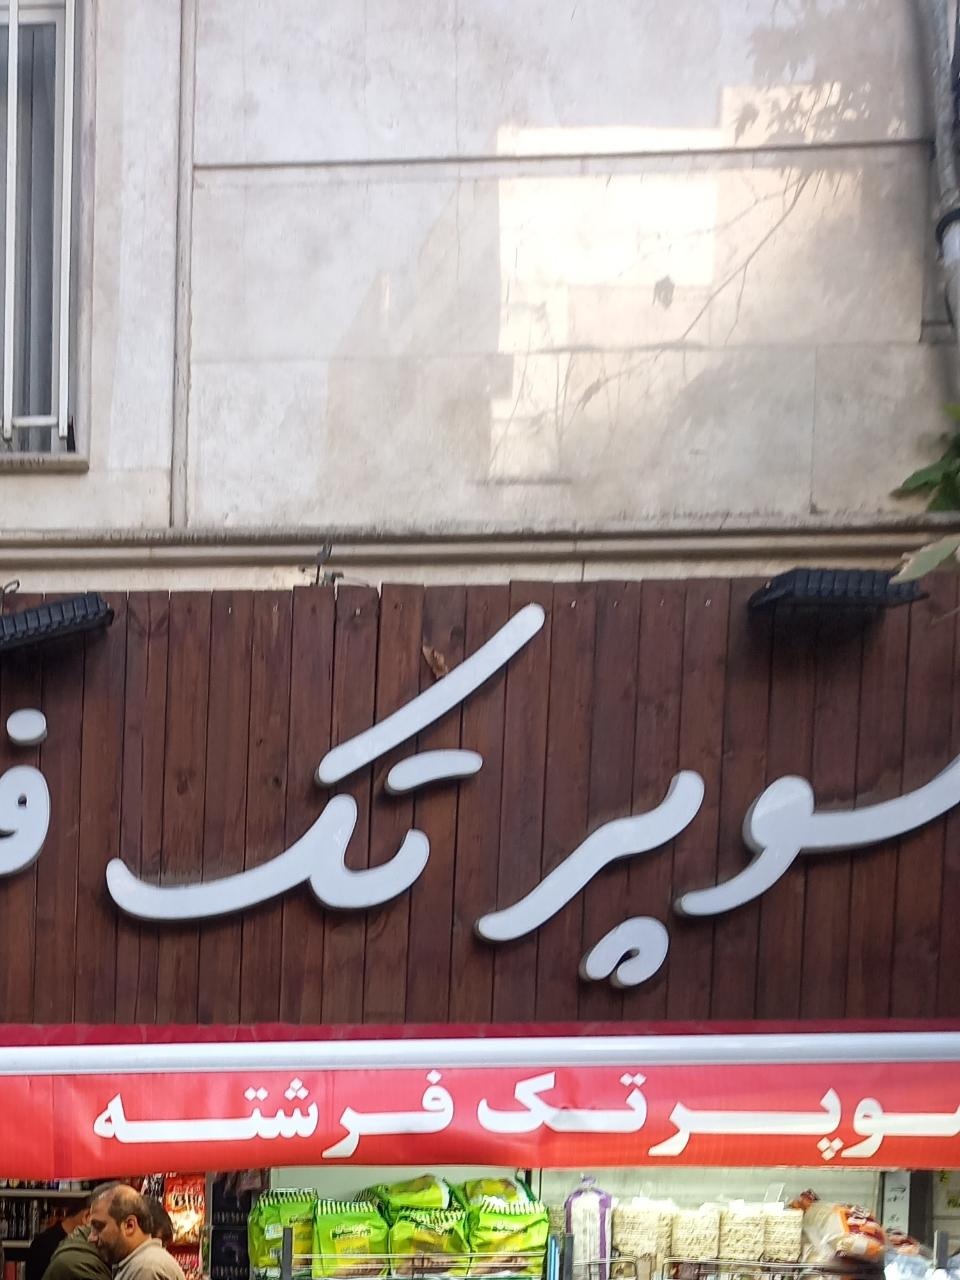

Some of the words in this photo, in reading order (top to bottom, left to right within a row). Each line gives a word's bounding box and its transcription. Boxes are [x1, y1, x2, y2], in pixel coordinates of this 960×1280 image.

[105, 602, 546, 921] تک
[474, 752, 960, 988] سوپر
[93, 1069, 455, 1159] فرشته
[476, 1071, 648, 1135] تک
[648, 1087, 960, 1160] وپر
